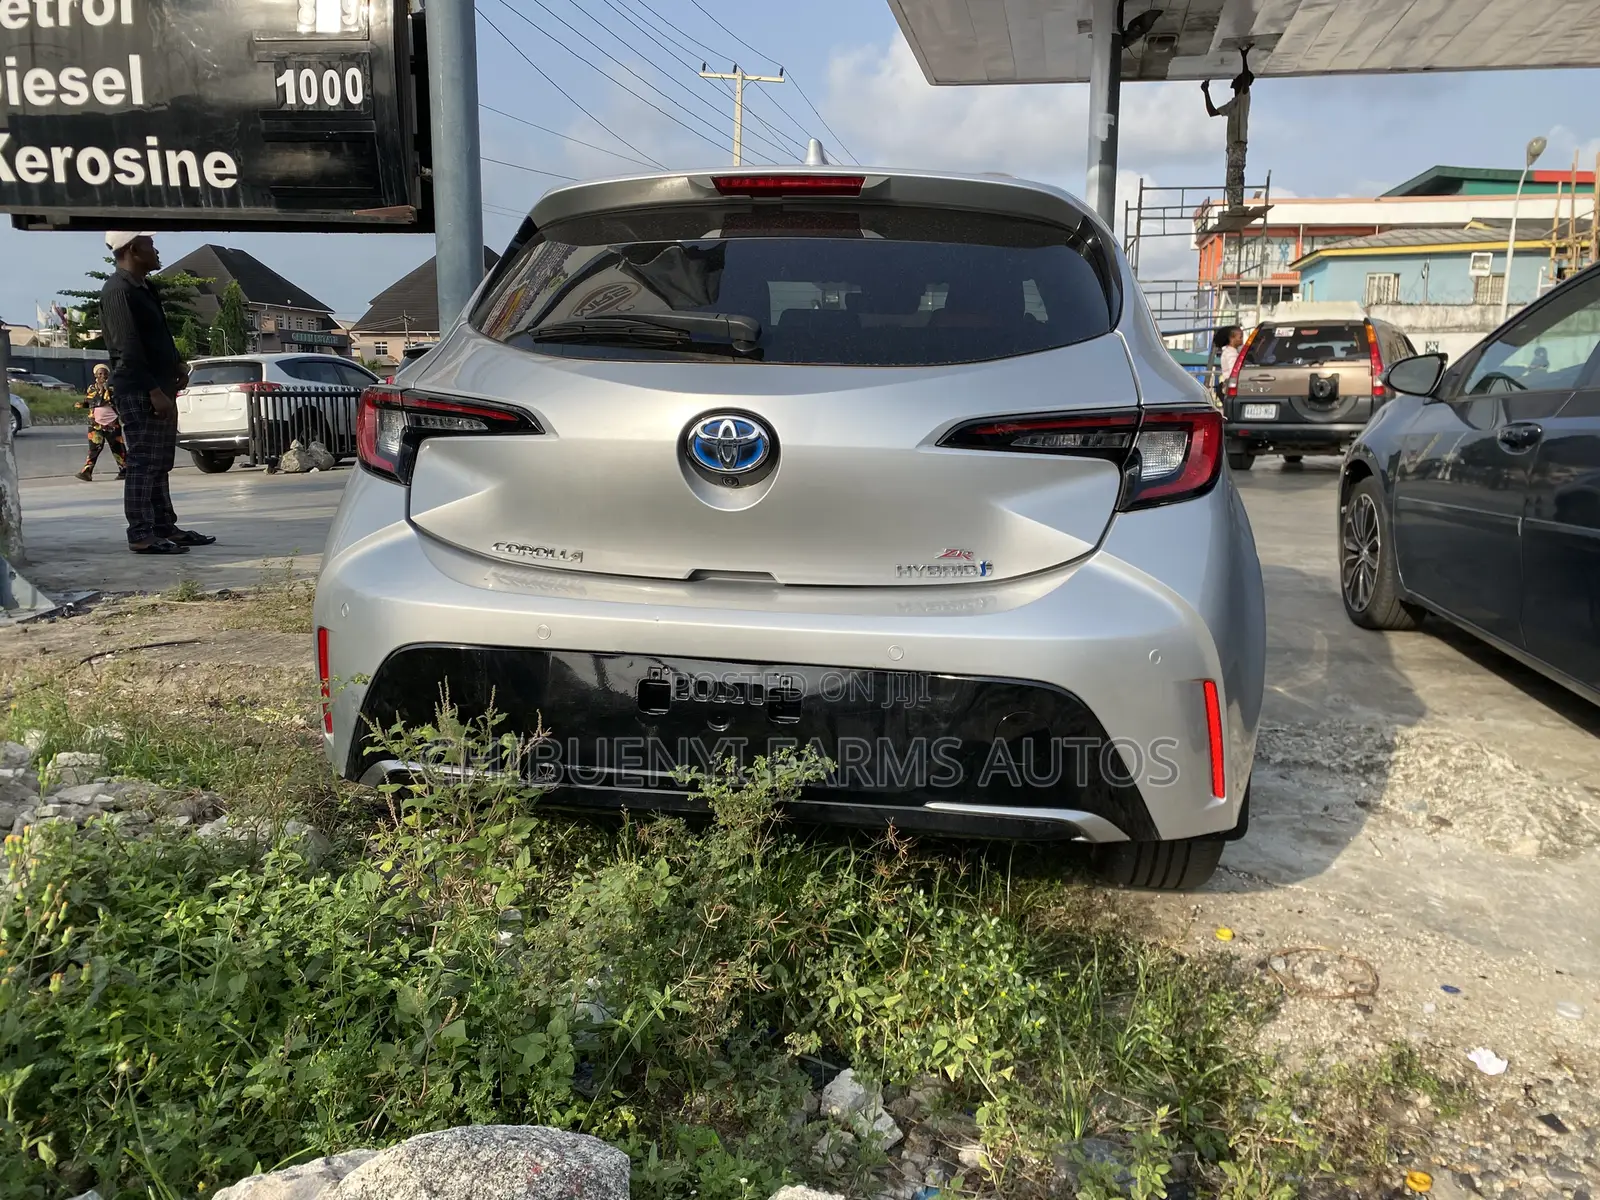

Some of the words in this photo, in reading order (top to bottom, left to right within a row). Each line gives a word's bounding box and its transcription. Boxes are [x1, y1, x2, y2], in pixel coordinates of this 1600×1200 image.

[0, 54, 143, 106] iesel
[276, 67, 363, 106] 1000
[491, 541, 584, 563] COROLLA
[896, 564, 977, 578] HYBRID
